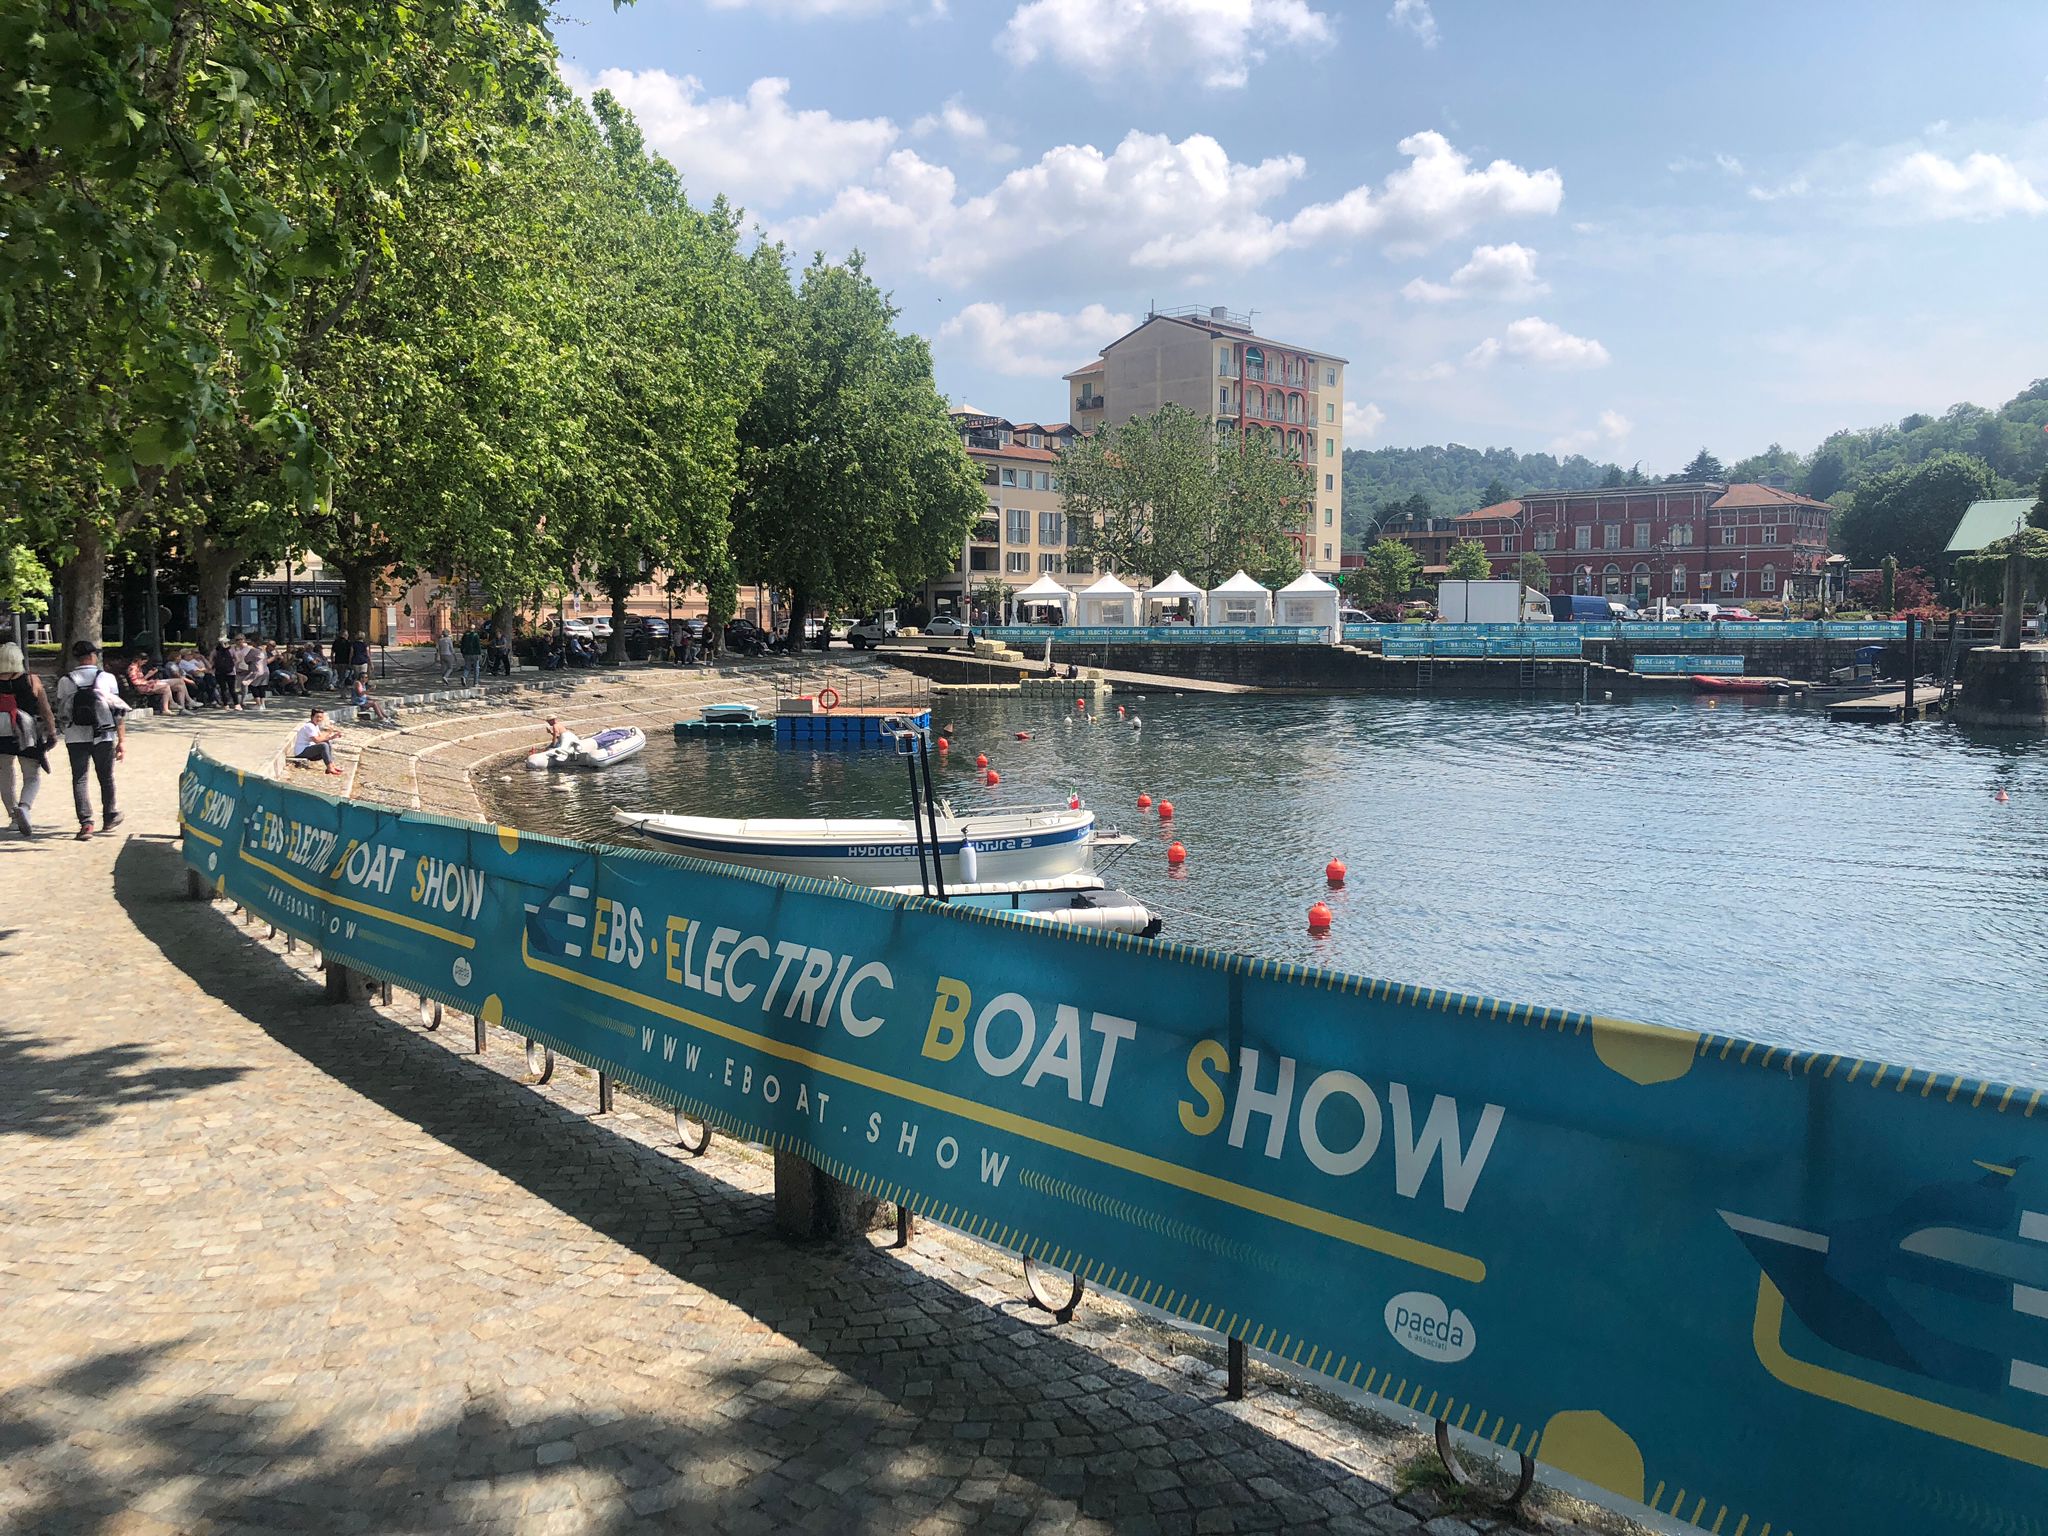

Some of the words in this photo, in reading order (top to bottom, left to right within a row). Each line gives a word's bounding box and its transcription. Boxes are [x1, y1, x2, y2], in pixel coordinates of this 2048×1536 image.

[201, 789, 236, 830] SHOW
[1021, 838, 1032, 848] 2
[261, 812, 284, 854] EBS
[287, 821, 339, 874] ELECTRIC
[330, 839, 405, 894] BOAT
[411, 855, 485, 920] SHOW
[591, 896, 645, 969] EBS
[666, 915, 894, 1038] ELECTRIC
[921, 976, 1137, 1108] BOAT
[1178, 1040, 1506, 1212] SHOW
[641, 1025, 1011, 1188] WWW.EBOAT.SHOW
[1394, 1307, 1464, 1348] paeda
